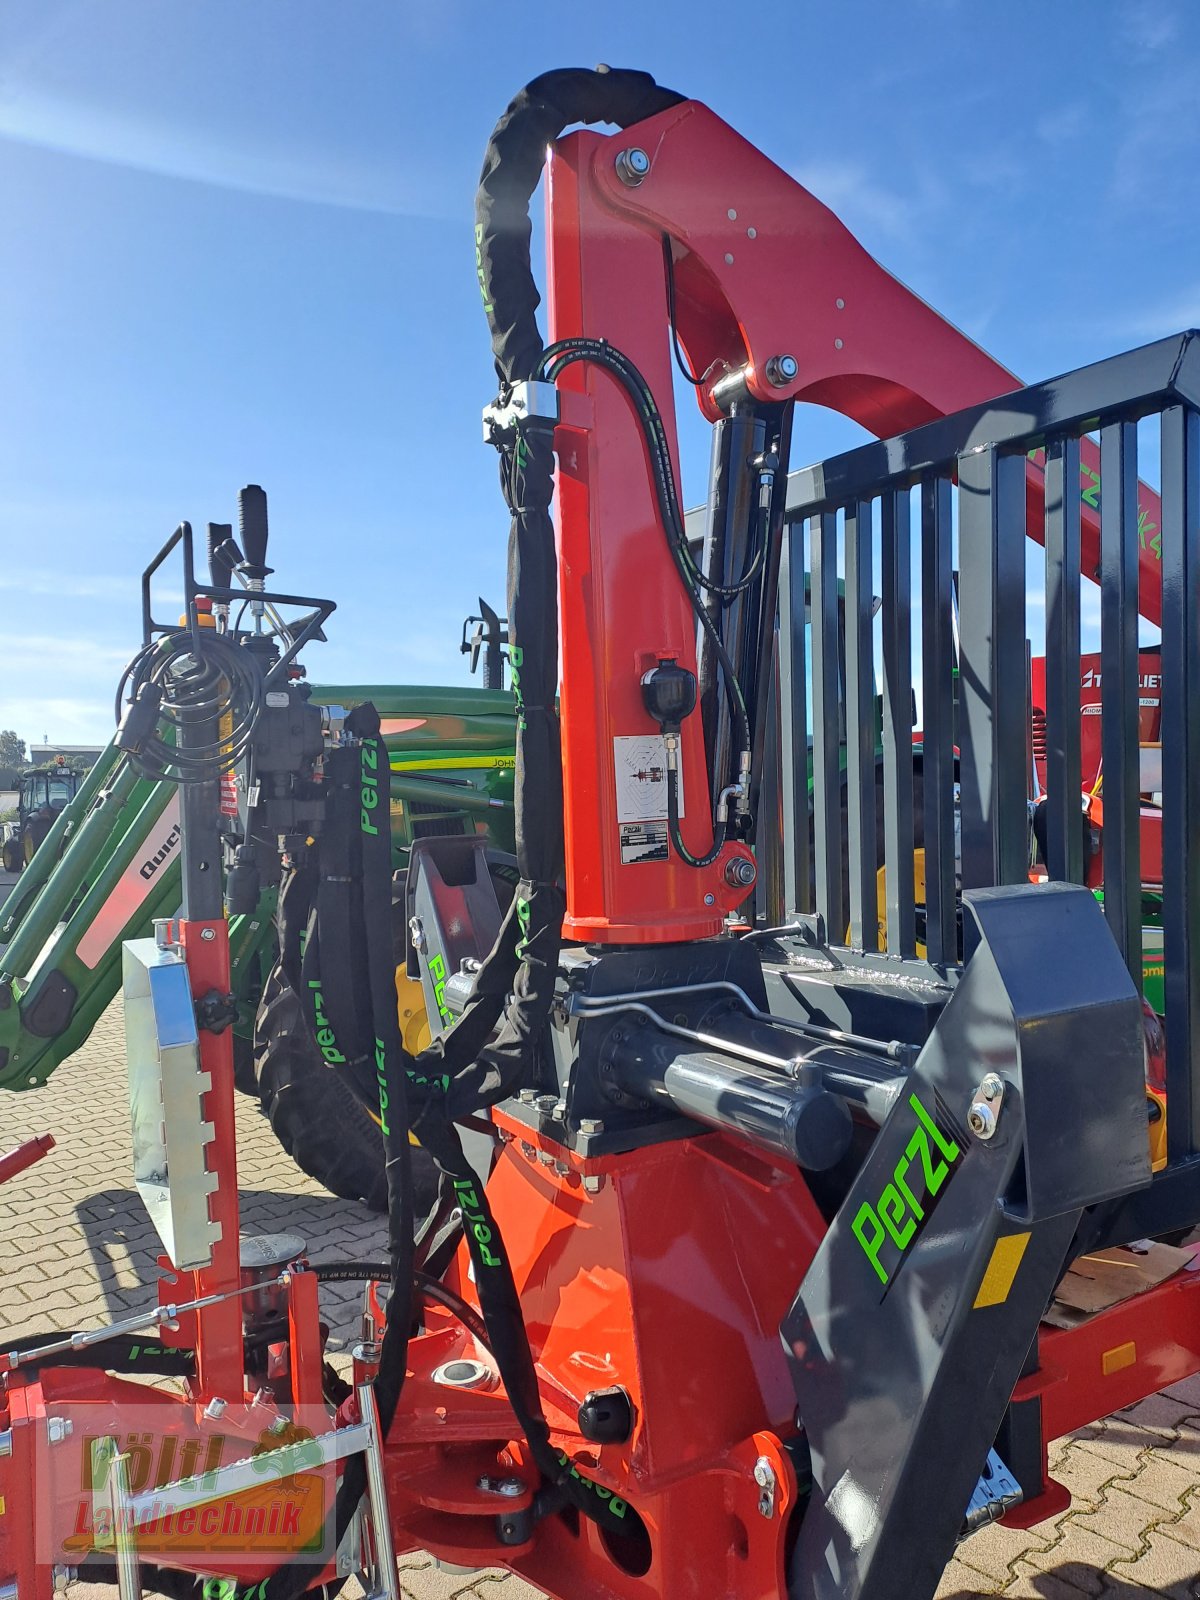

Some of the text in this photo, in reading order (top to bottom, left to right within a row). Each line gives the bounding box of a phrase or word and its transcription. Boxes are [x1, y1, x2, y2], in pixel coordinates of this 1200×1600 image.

[360, 738, 379, 837] Perzl
[453, 1180, 502, 1267] Perzl
[851, 1092, 960, 1285] Perzl
